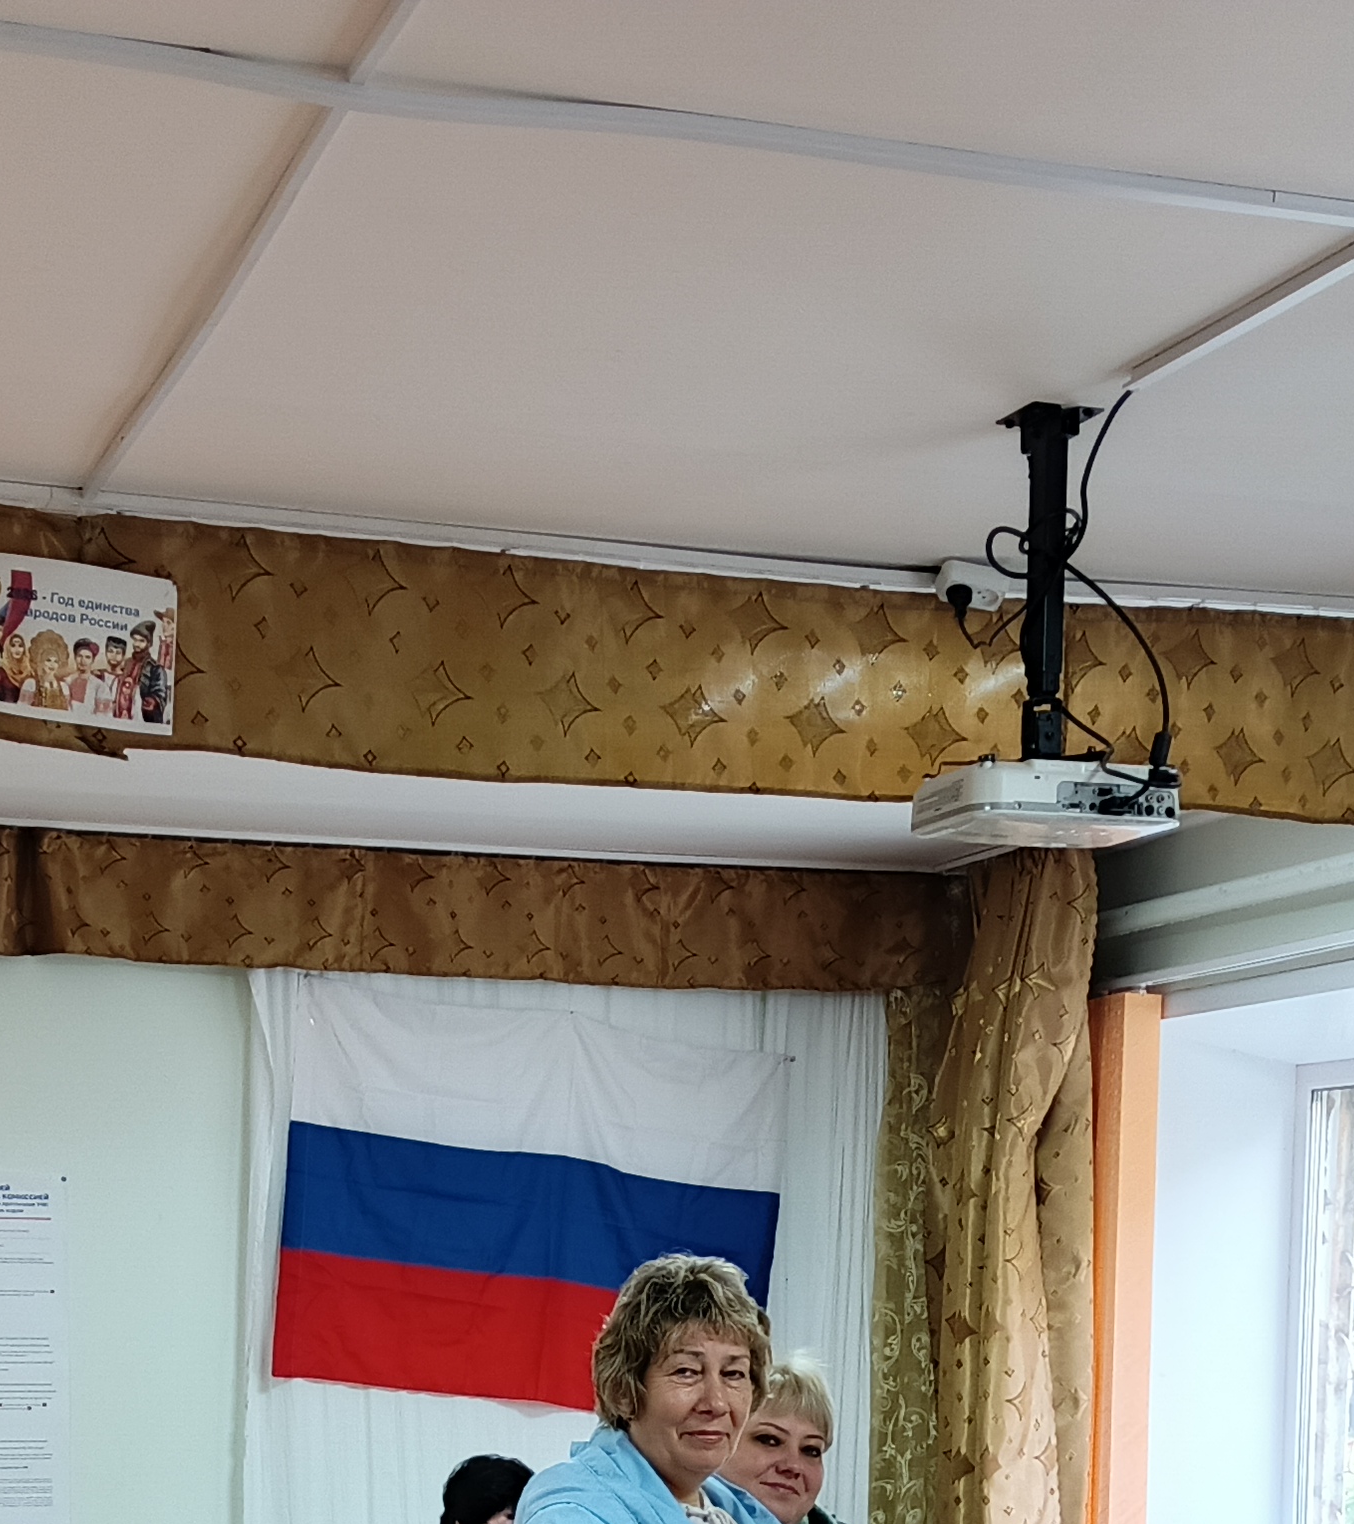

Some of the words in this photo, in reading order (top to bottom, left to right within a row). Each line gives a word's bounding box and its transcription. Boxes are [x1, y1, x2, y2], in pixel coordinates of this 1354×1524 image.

[50, 592, 75, 608] Год
[78, 599, 140, 617] единства
[24, 608, 76, 623] ародов
[80, 613, 129, 631] России
